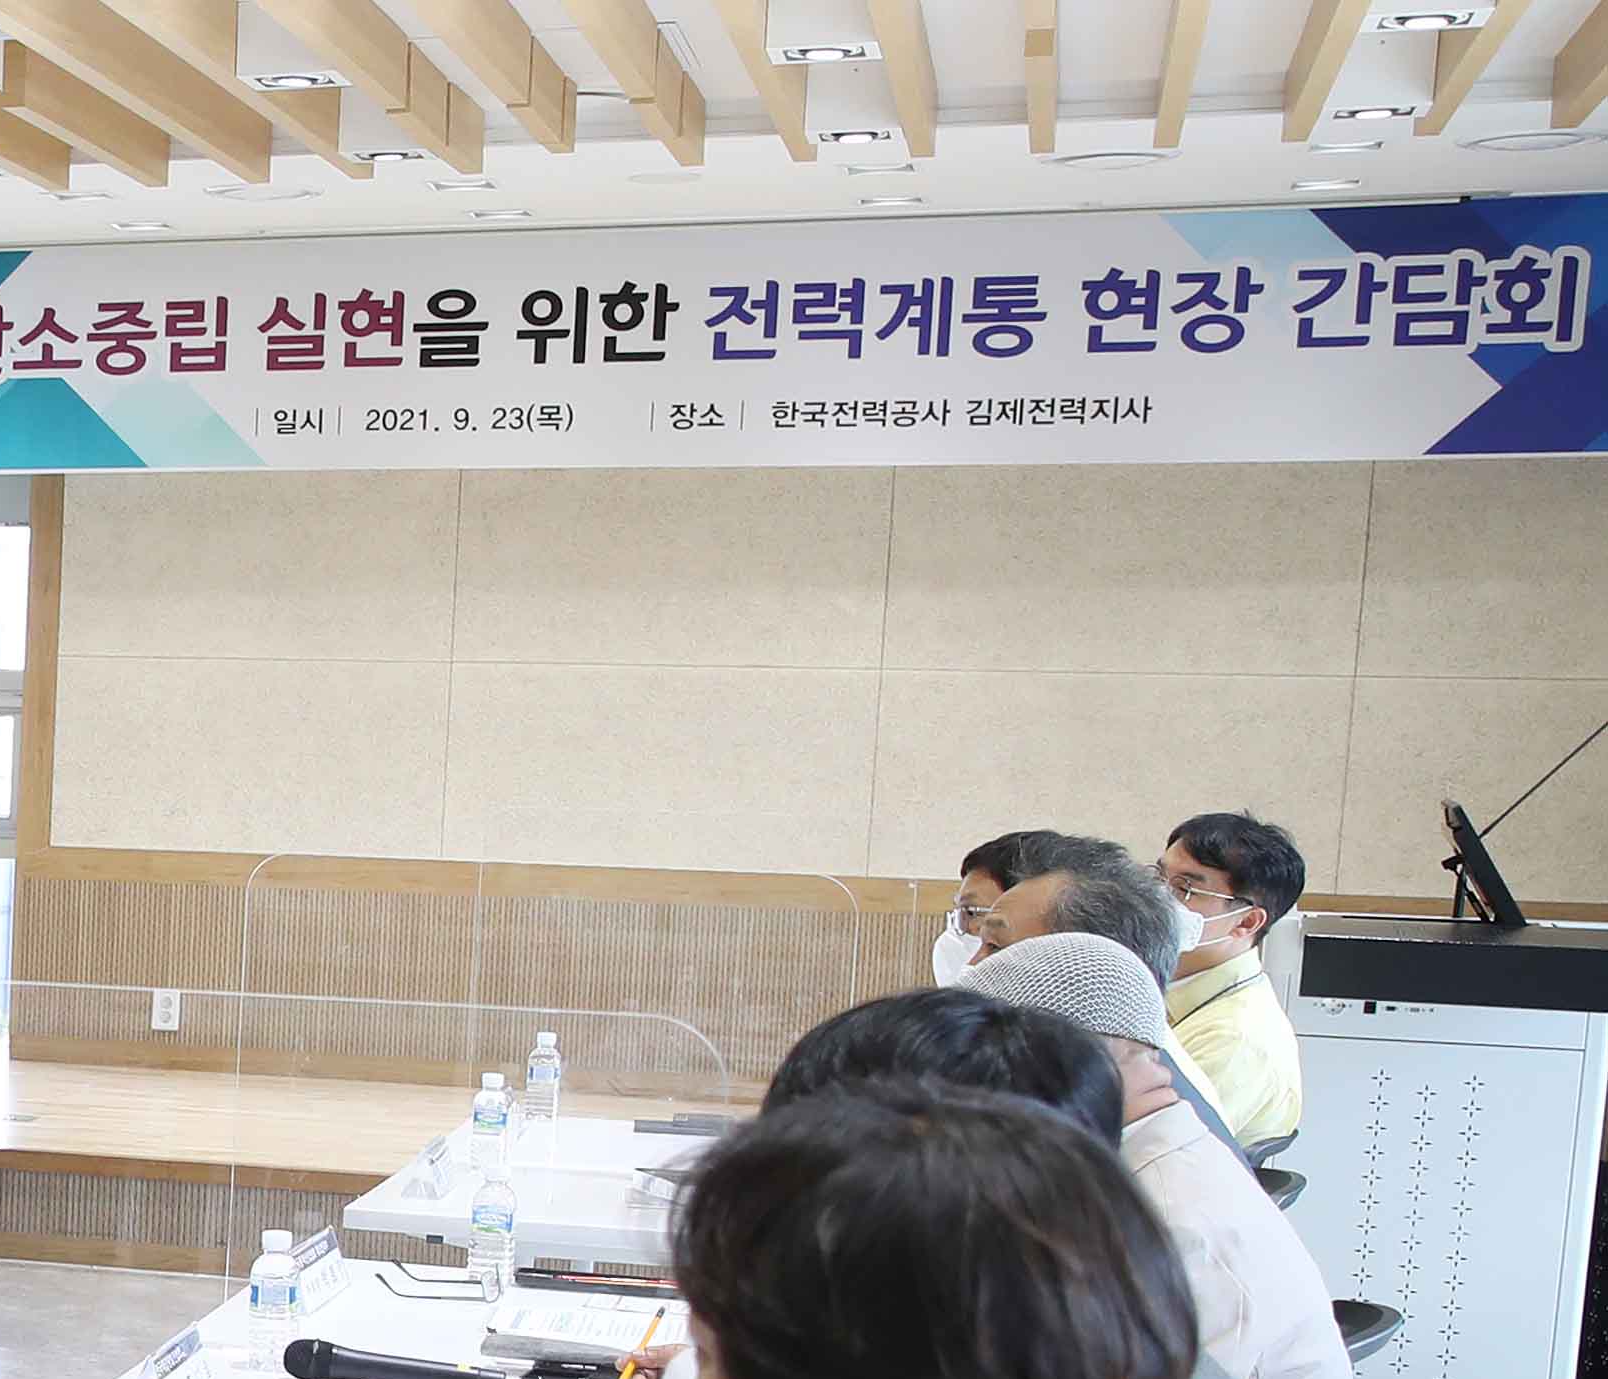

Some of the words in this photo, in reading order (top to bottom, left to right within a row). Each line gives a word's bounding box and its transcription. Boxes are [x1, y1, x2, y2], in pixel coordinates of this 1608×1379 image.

[256, 287, 491, 372] 실현을
[515, 279, 681, 366] 위한
[705, 275, 1046, 360] 전력계통
[1082, 265, 1263, 355] 현장
[1292, 255, 1582, 350] 간담회
[272, 406, 324, 436] 일시
[364, 406, 441, 433] 2021.
[452, 406, 477, 432] 9.
[490, 401, 575, 434] 23(목)
[668, 401, 726, 431] 장소
[770, 398, 952, 429] 한국전력공사
[965, 394, 1154, 427] 김제전력지사
